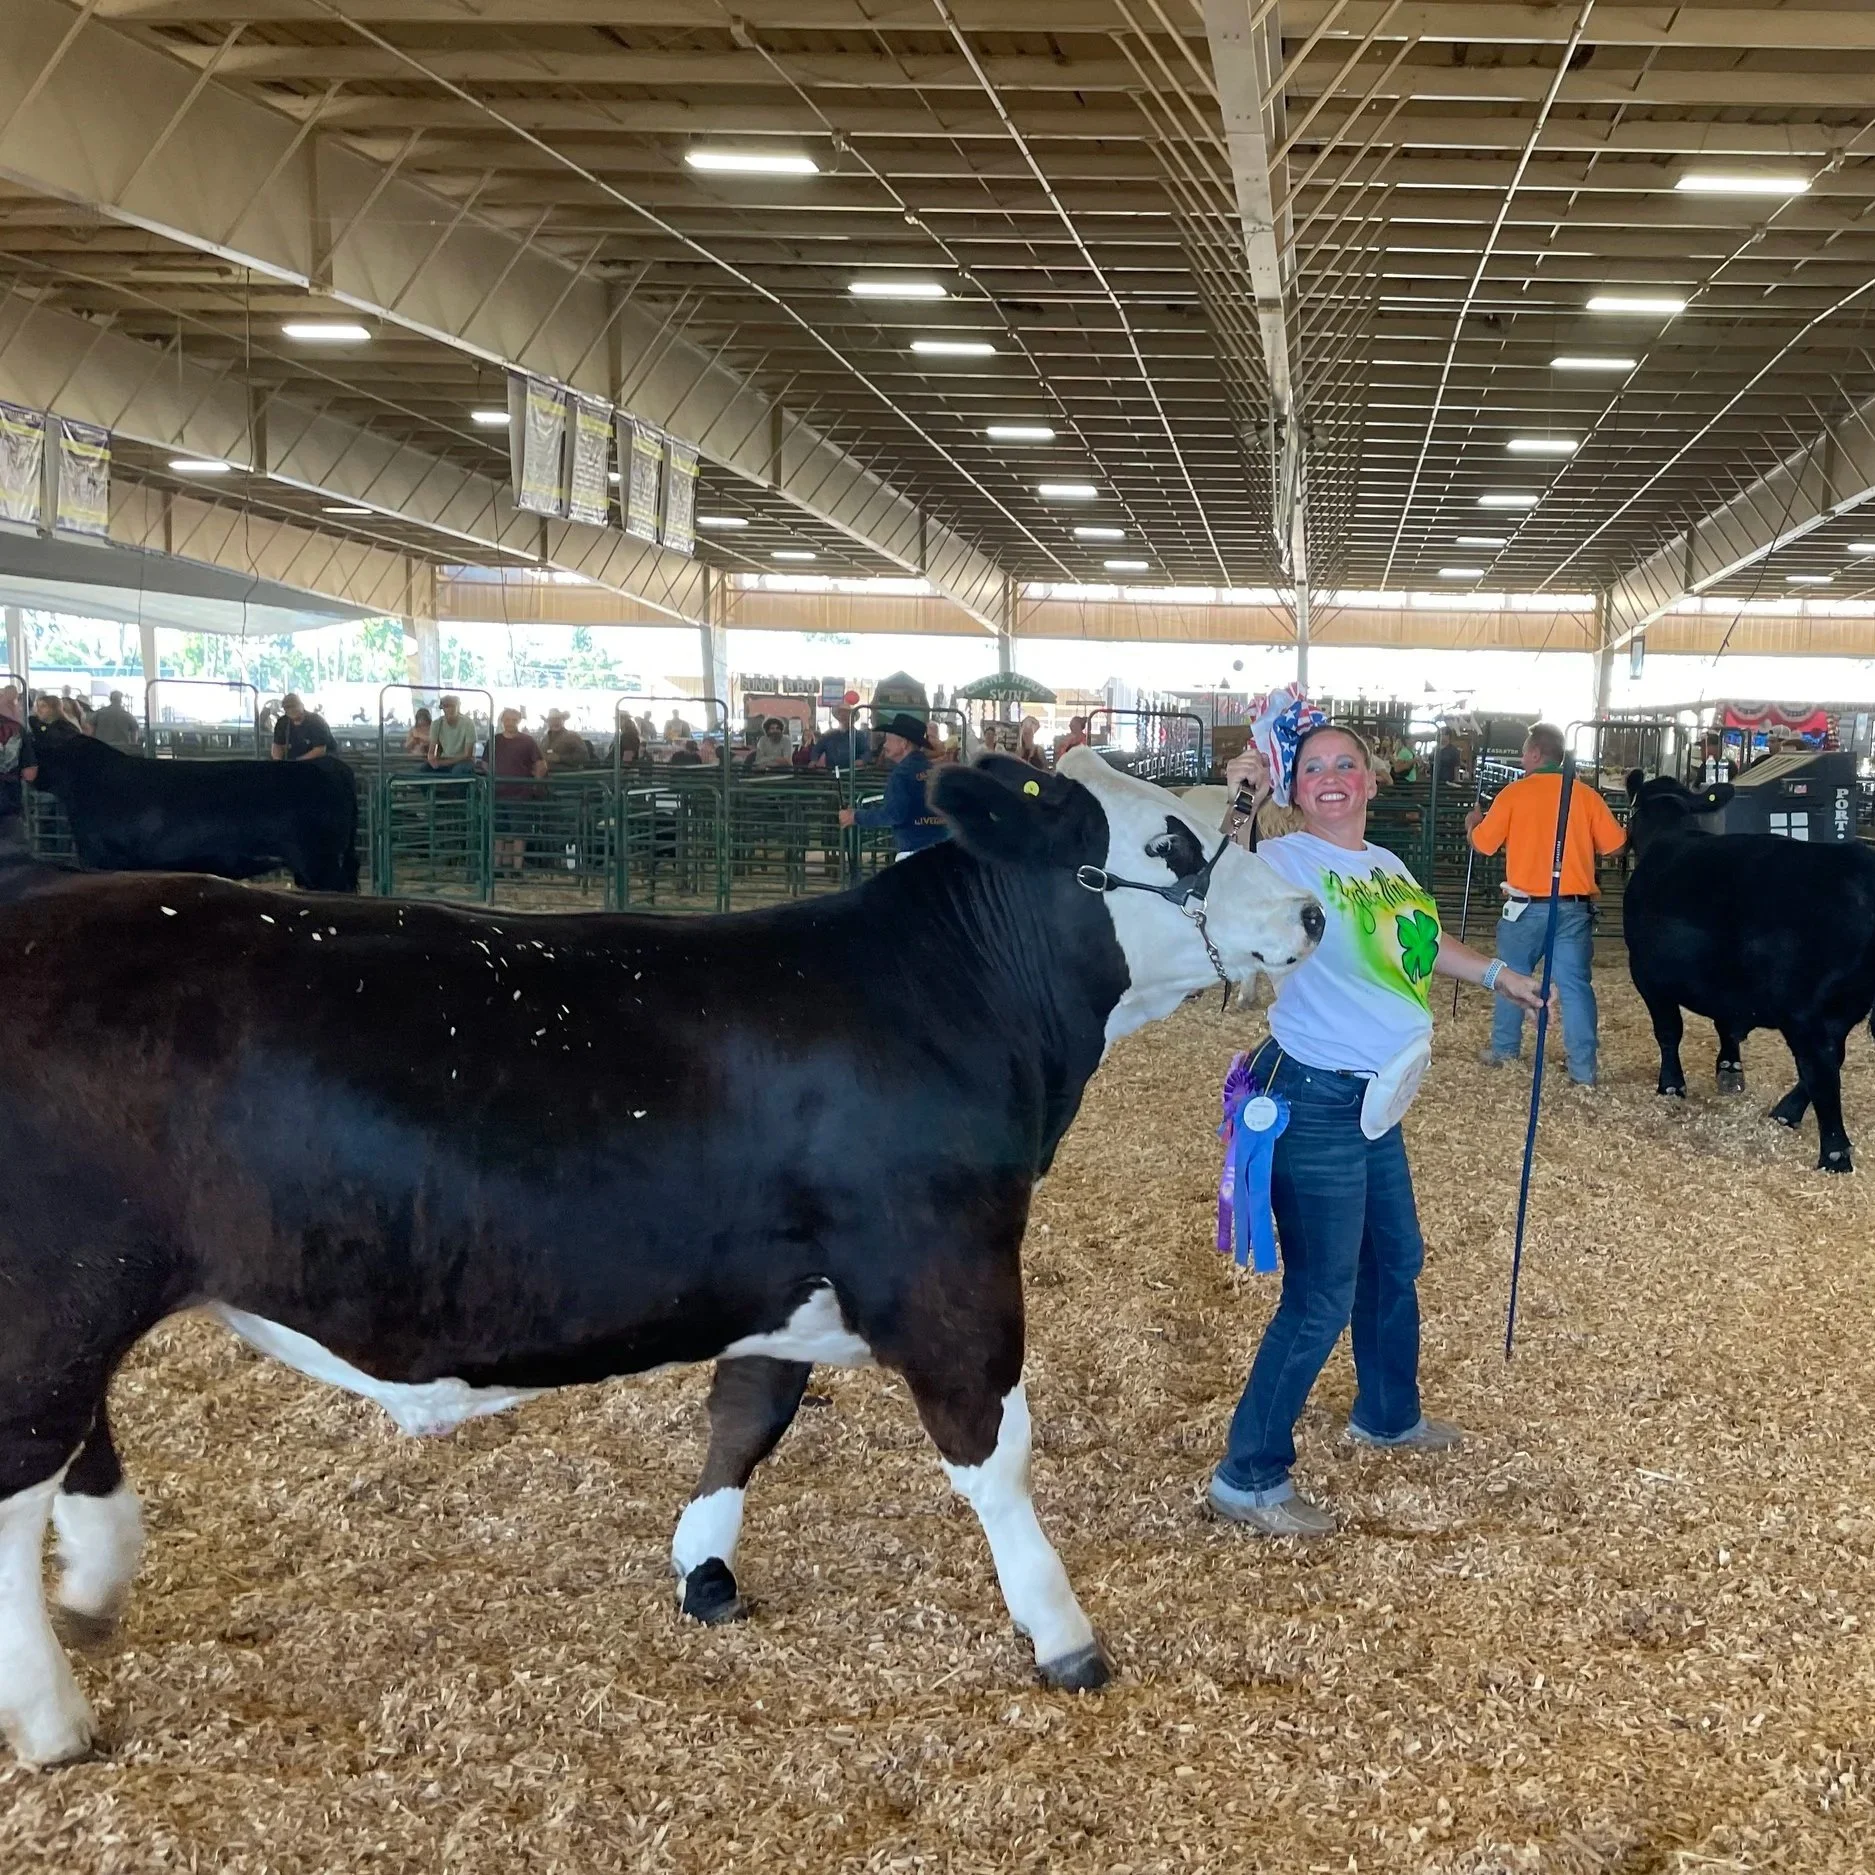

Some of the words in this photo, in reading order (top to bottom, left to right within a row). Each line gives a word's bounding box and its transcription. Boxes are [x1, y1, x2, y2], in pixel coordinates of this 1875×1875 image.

[741, 678, 778, 692] SUNOL
[989, 689, 1030, 701] SWINE
[1479, 747, 1519, 755] PEASANTON
